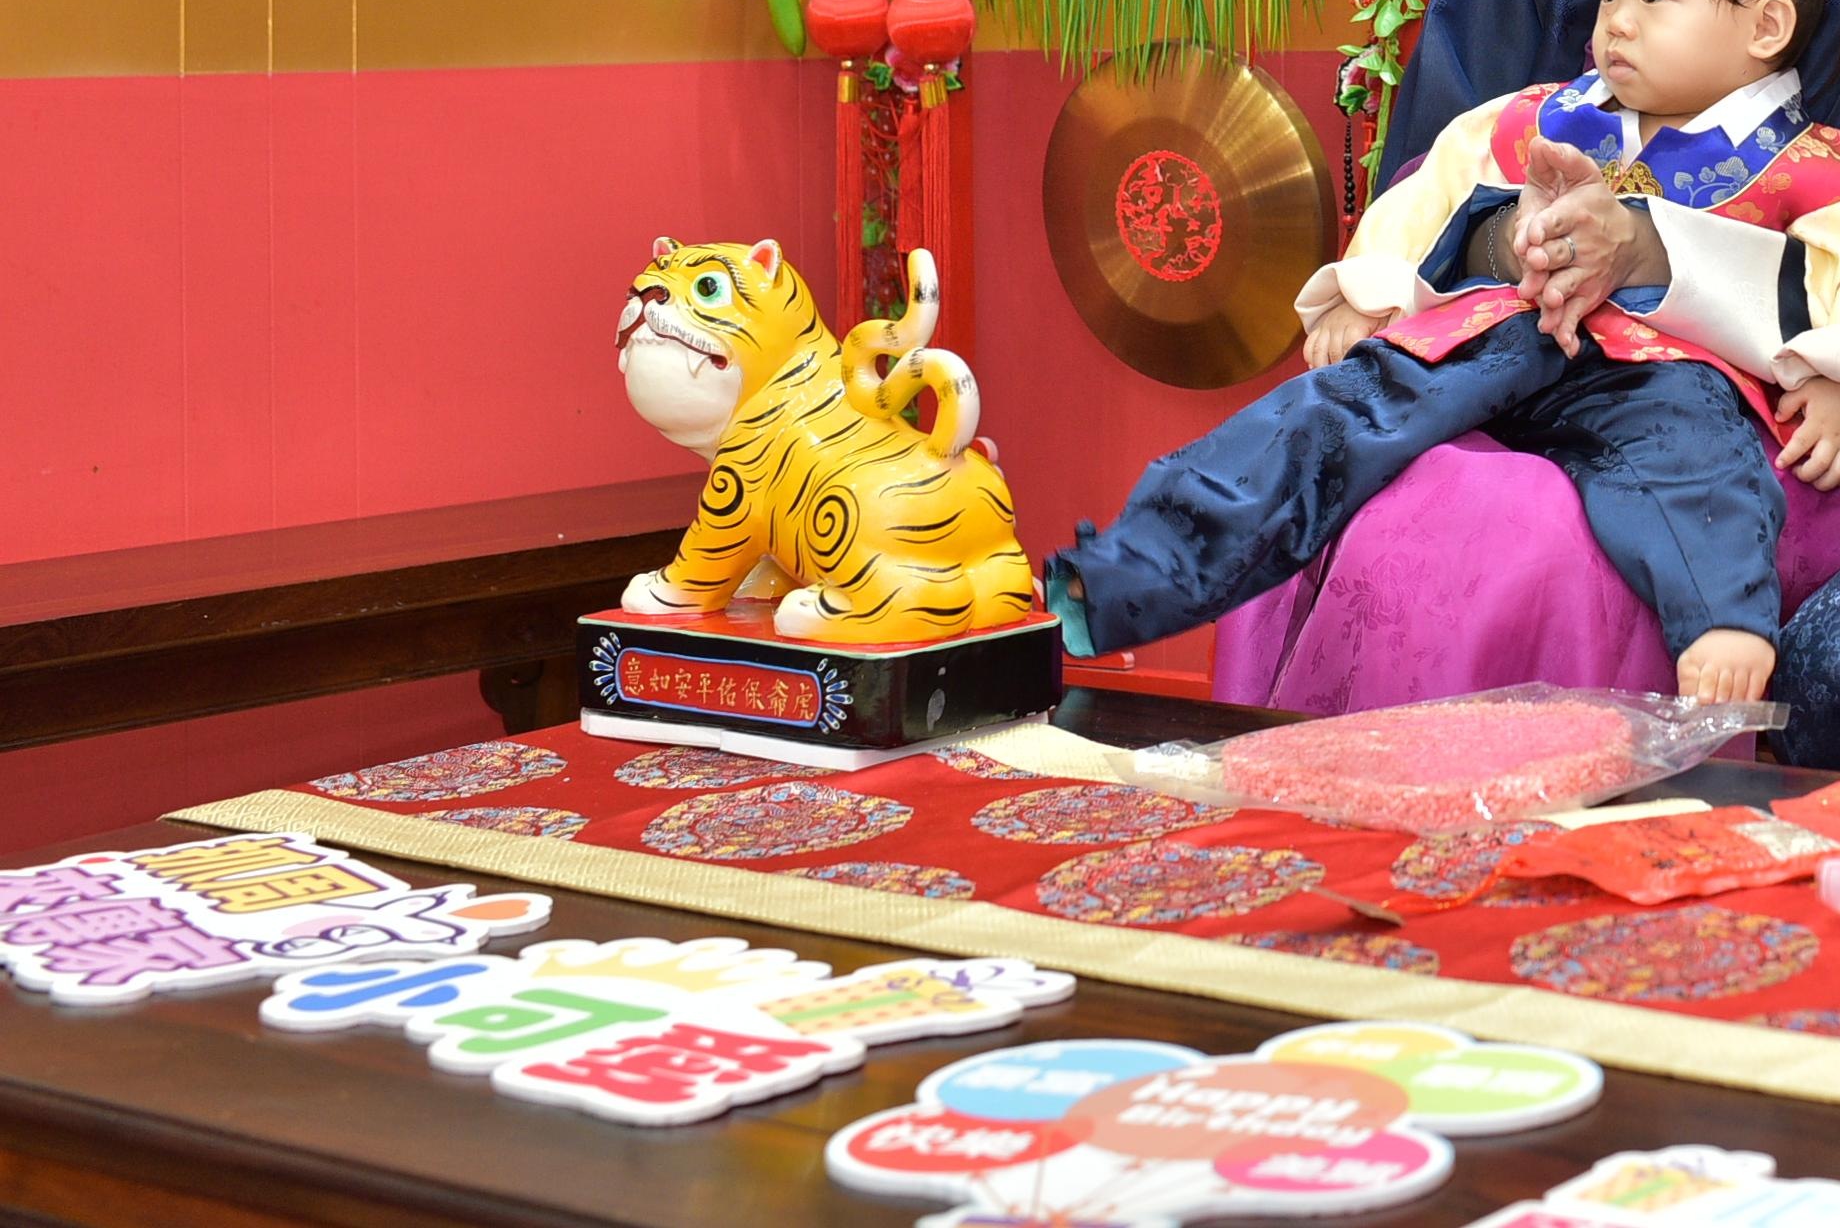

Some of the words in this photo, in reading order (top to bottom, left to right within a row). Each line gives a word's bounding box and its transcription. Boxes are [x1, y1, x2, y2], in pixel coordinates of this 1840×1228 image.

[123, 837, 389, 914] 抓周
[288, 964, 832, 1103] 小可愛
[1118, 1103, 1373, 1148] Birthday
[1131, 1073, 1358, 1125] Happy
